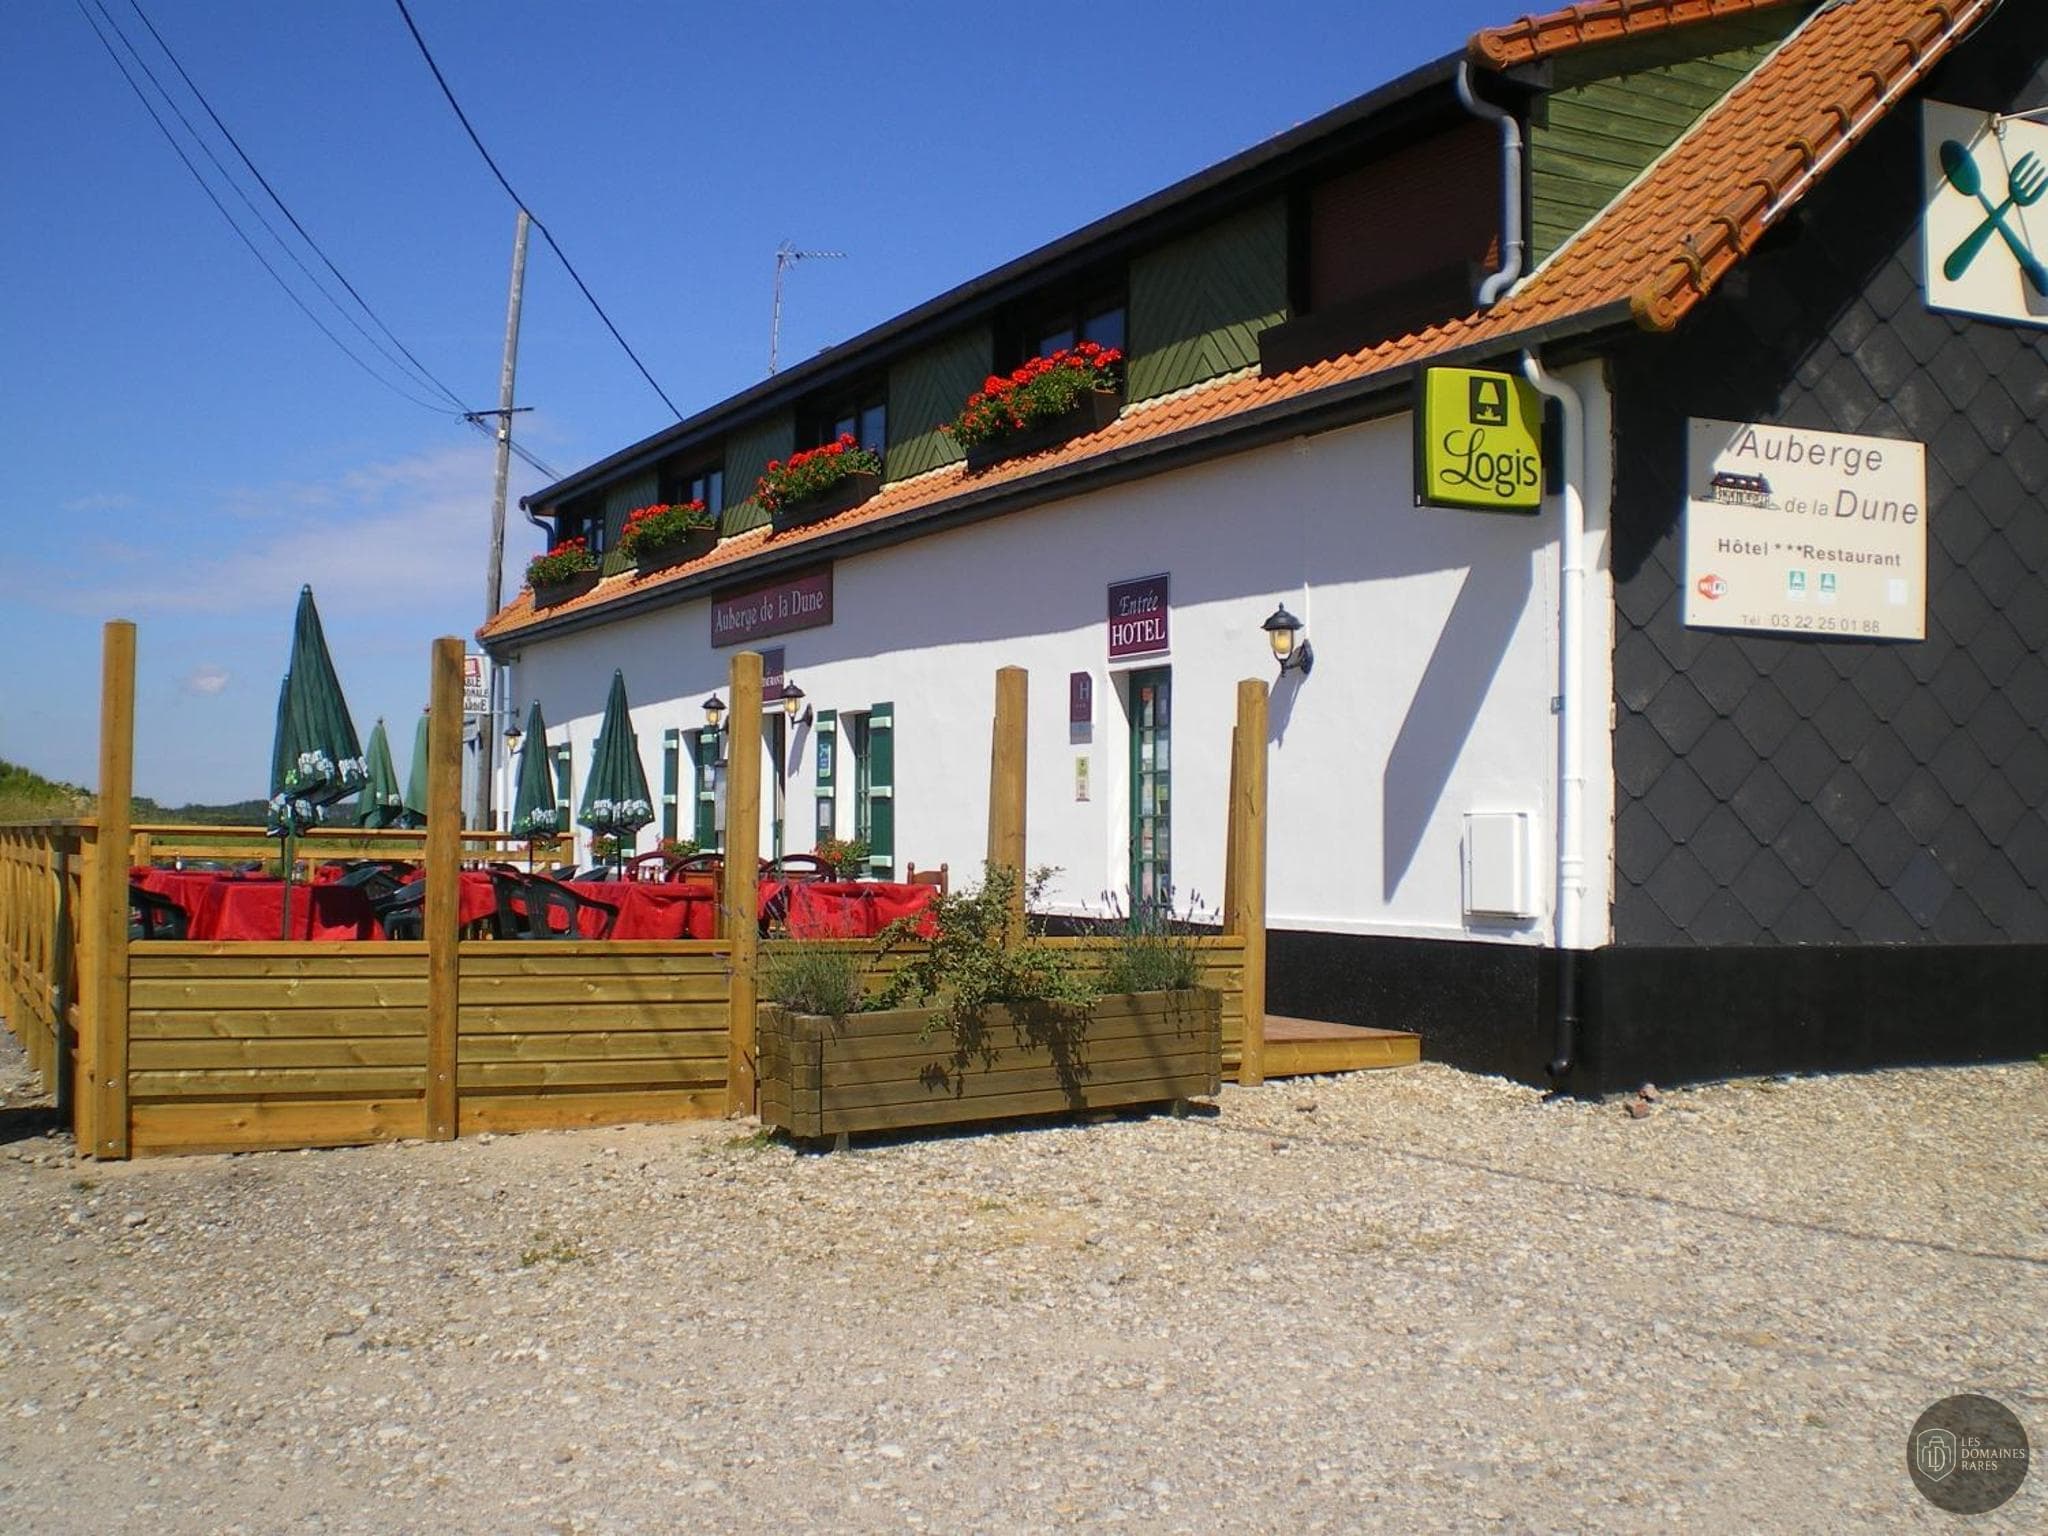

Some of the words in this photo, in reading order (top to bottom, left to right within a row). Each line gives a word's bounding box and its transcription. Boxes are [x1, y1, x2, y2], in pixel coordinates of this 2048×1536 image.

[1439, 428, 1538, 498] Logis
[1736, 429, 1884, 476] Auberge
[1784, 498, 1808, 515] de
[1812, 502, 1829, 516] la
[1834, 489, 1920, 525] Dune
[1718, 538, 1768, 556] Hôtel
[1803, 544, 1902, 567] Restaurant
[715, 606, 758, 633] Auberge
[760, 595, 774, 621] de
[779, 595, 789, 618] la
[792, 590, 824, 615] Dune
[1120, 589, 1159, 617] Entrée
[1111, 618, 1166, 647] HOTEL
[1770, 613, 1790, 628] 03
[1794, 615, 1814, 629] 22
[1818, 616, 1836, 630] 25
[1840, 618, 1857, 632] 01
